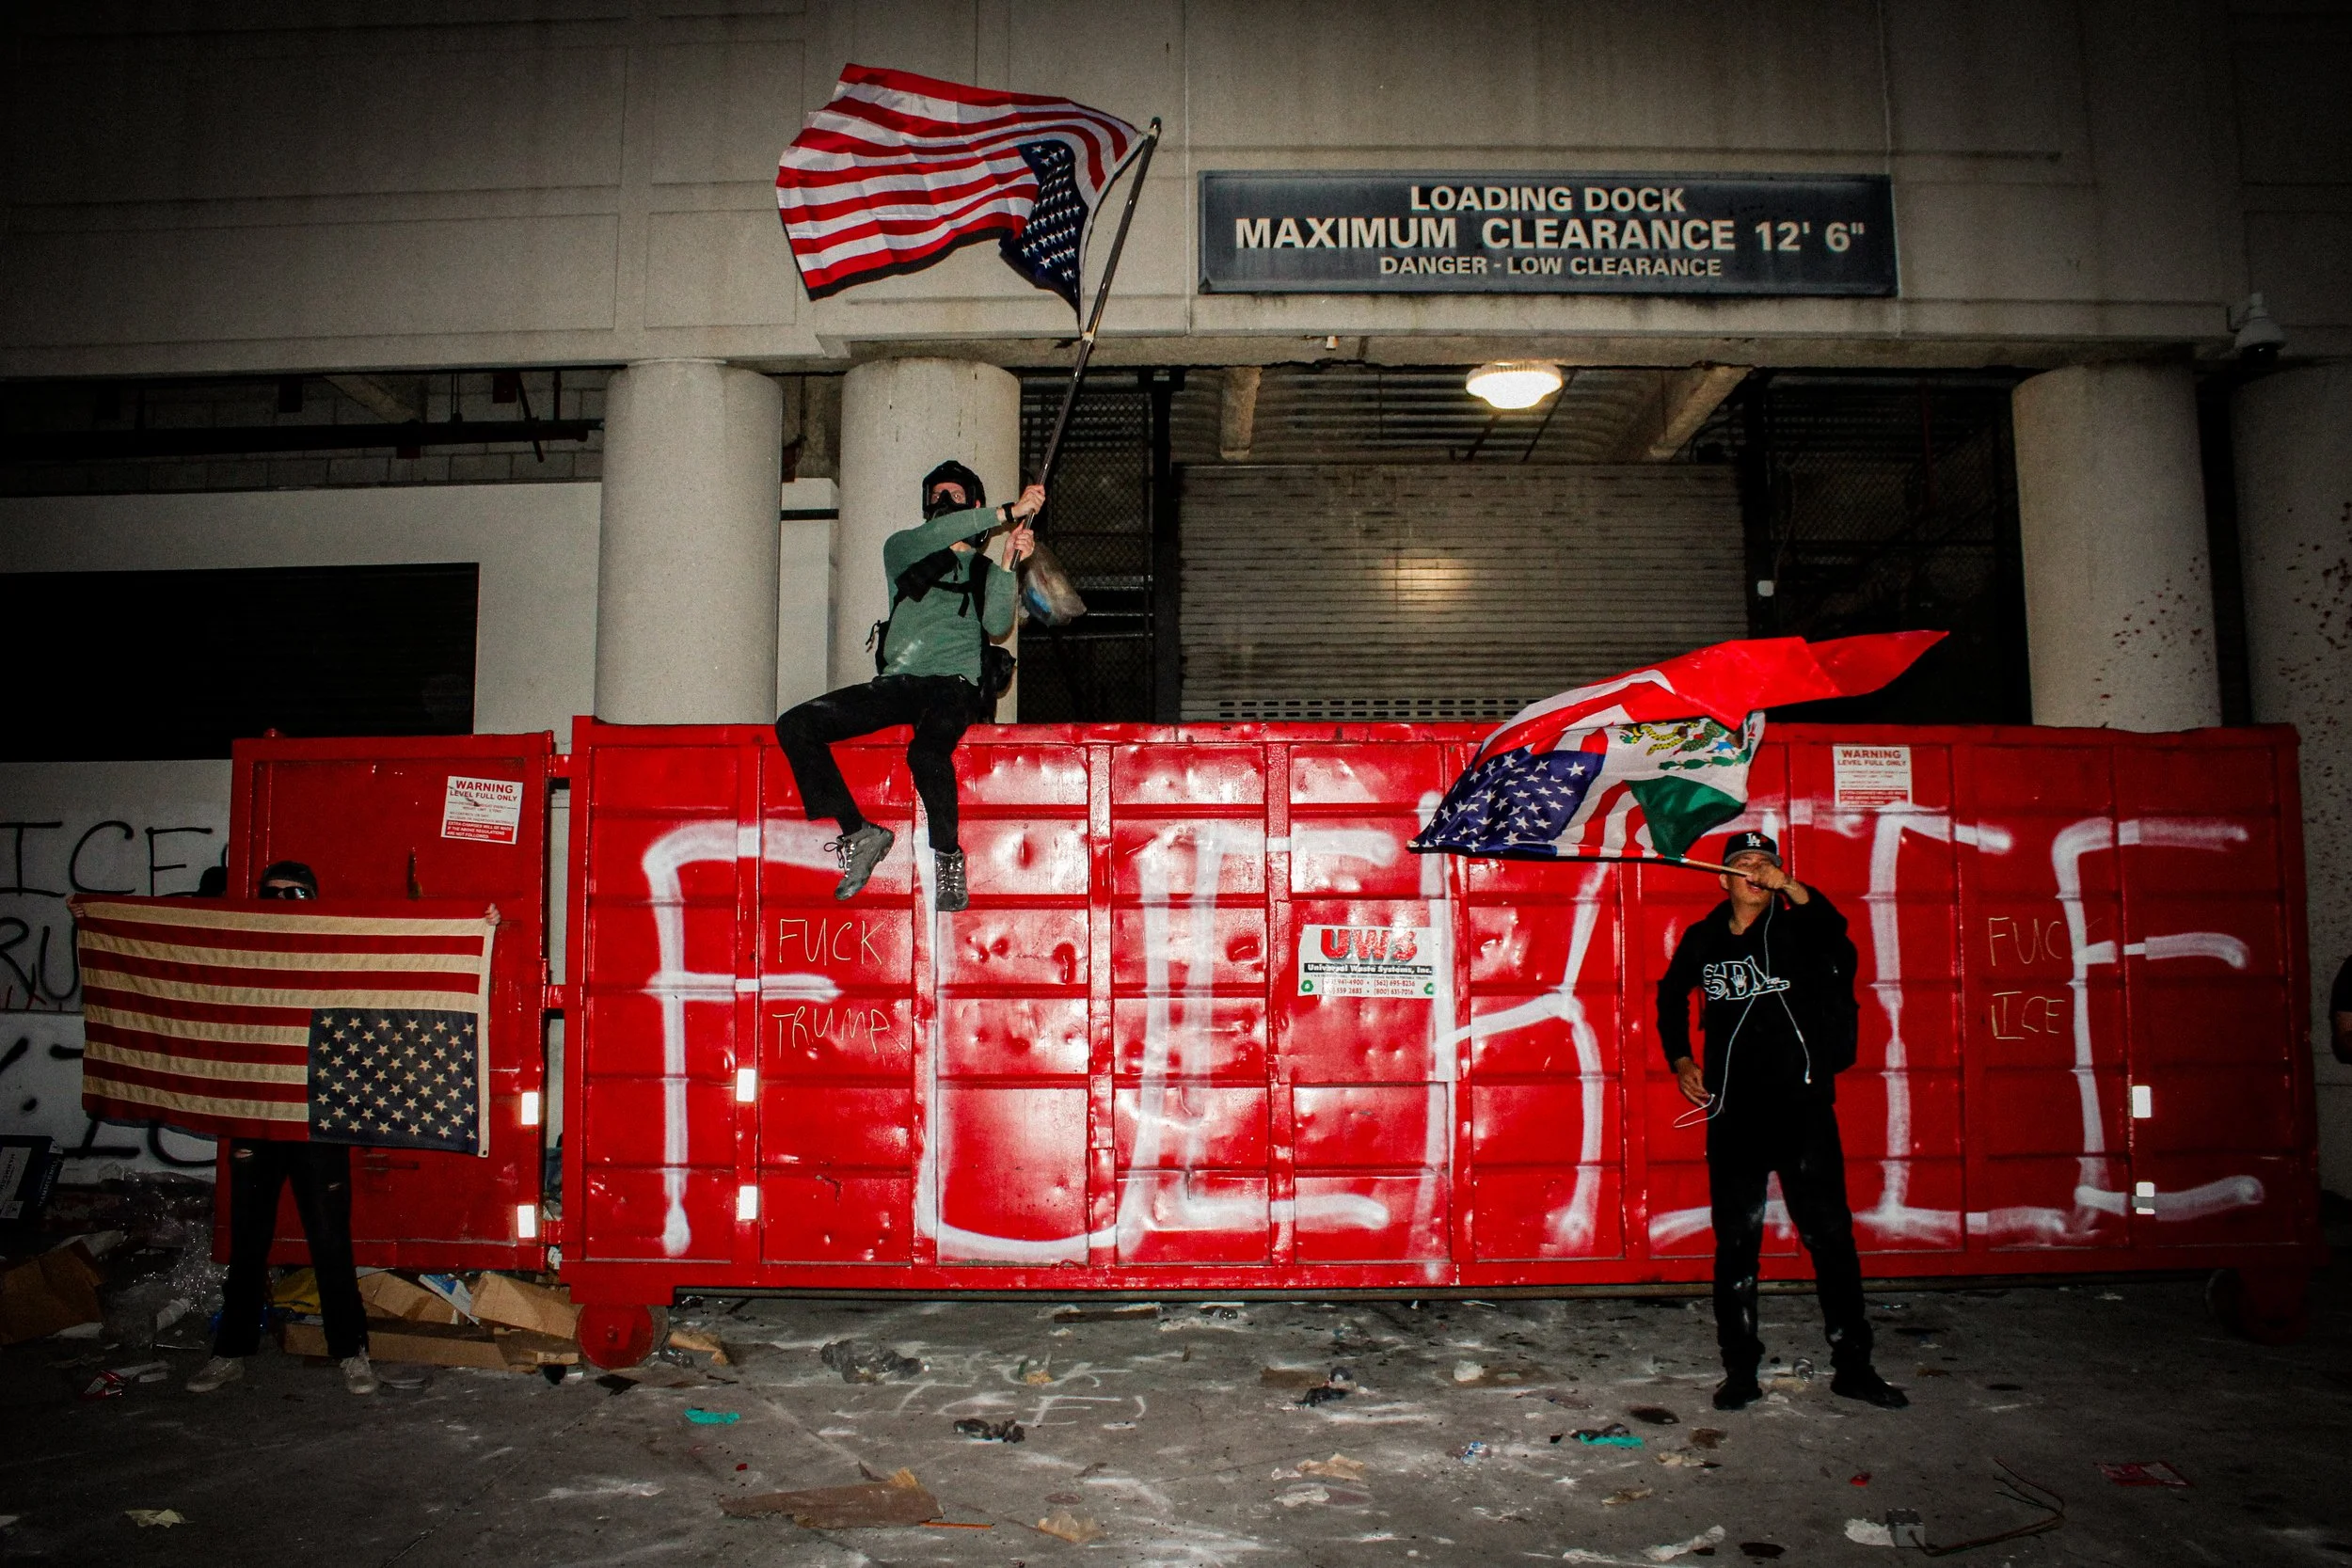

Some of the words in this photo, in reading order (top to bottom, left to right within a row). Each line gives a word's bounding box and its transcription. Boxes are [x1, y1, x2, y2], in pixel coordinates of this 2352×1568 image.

[1411, 185, 1572, 213] LOADING
[1583, 186, 1686, 214] DOCK
[1234, 217, 1456, 250] MAXIMUM
[1481, 217, 1736, 251] CLEARANCE
[1755, 221, 1811, 252] 12'
[1825, 222, 1865, 253] 6"
[1379, 255, 1487, 275] DANGER
[1506, 256, 1563, 276] LOW
[1570, 257, 1723, 277] CLEARANCE
[1841, 750, 1901, 759] WARNING
[455, 780, 514, 794] WARNING
[1746, 832, 1761, 847] LA
[779, 918, 886, 966] FUCK
[1320, 928, 1419, 963] UWS
[1988, 916, 2102, 967] FUC
[1349, 963, 1376, 974] Waste
[1377, 964, 1415, 975] Systems,
[1417, 966, 1432, 974] Inc.
[1992, 991, 2065, 1039] ICE
[772, 1006, 891, 1059] TRUMP
